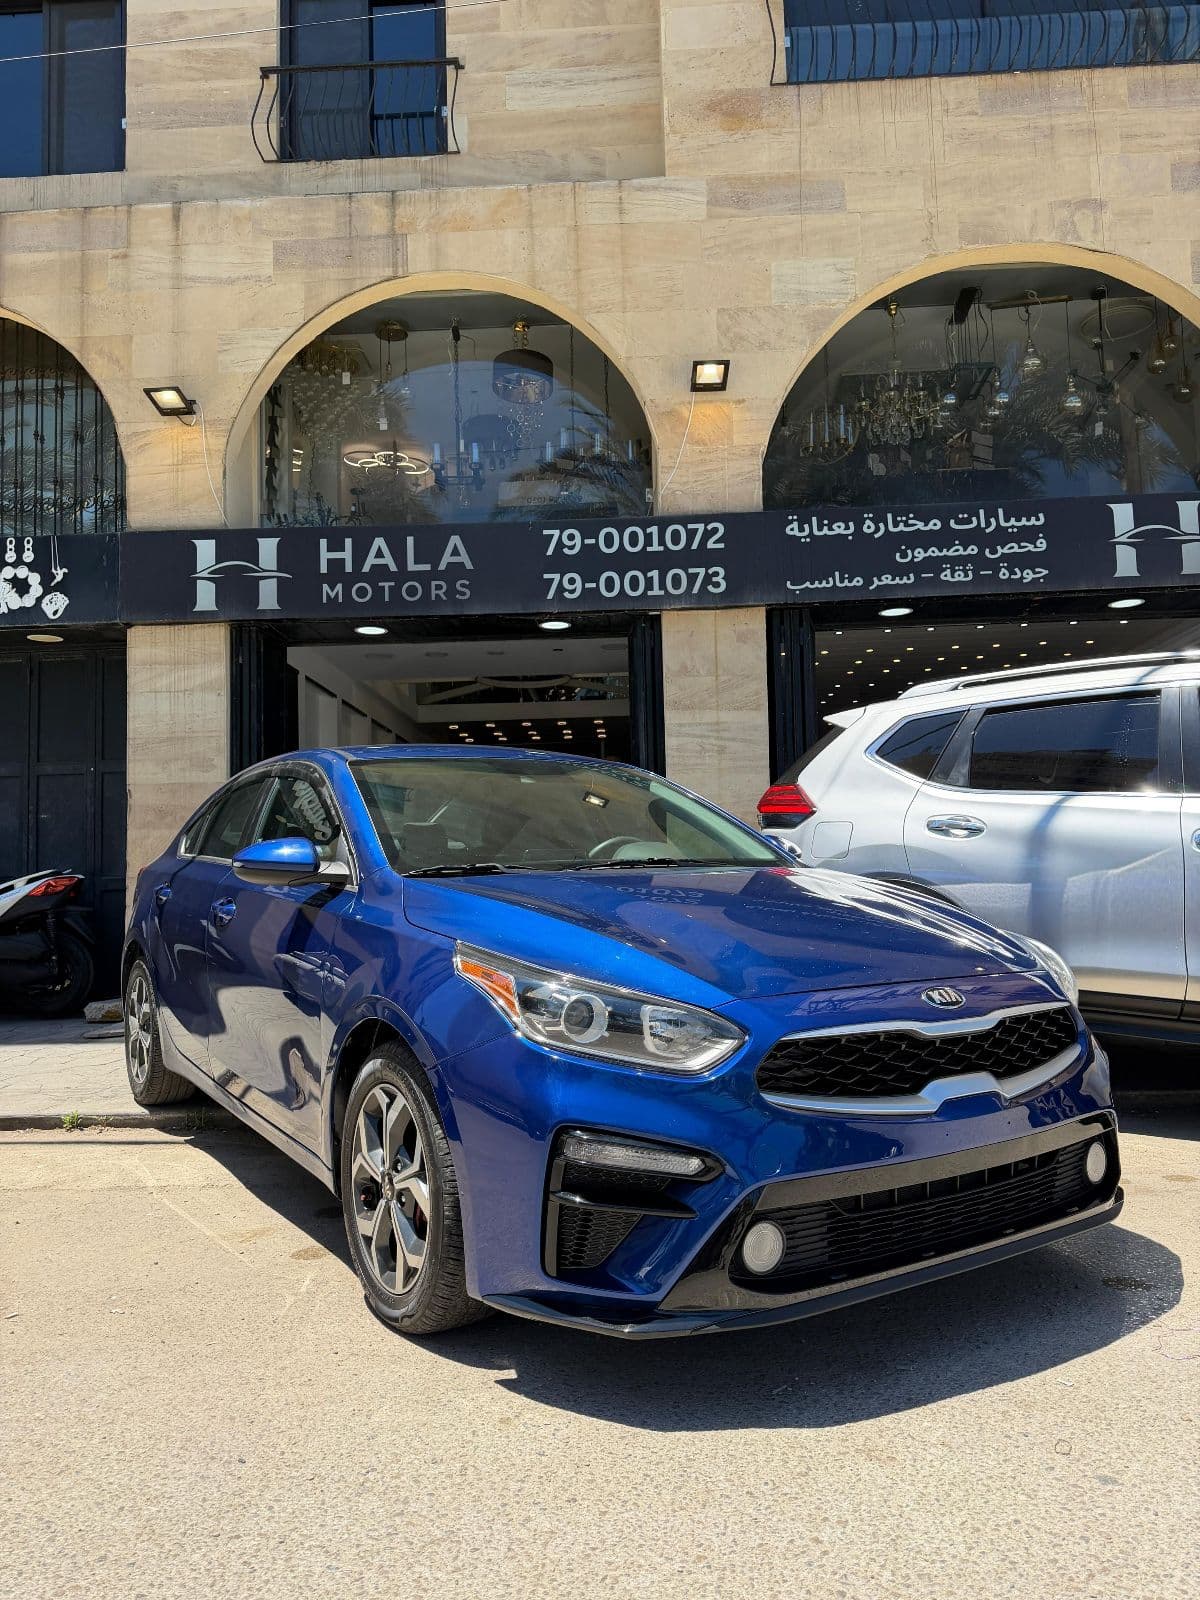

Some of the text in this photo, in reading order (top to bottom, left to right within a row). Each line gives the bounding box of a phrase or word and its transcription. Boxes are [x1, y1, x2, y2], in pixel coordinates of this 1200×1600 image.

[785, 508, 1045, 543] سيارات مختارة بعناية
[542, 522, 725, 556] 79-001072
[895, 533, 1047, 562] فحص مضمون
[319, 535, 475, 574] HALA
[542, 566, 727, 600] 79-001073
[786, 571, 864, 594] مناسب
[868, 572, 915, 590] سعر
[940, 563, 974, 582] ثقة
[998, 562, 1049, 582] جودة
[322, 579, 472, 604] MOTORS
[926, 988, 963, 1004] KIA
